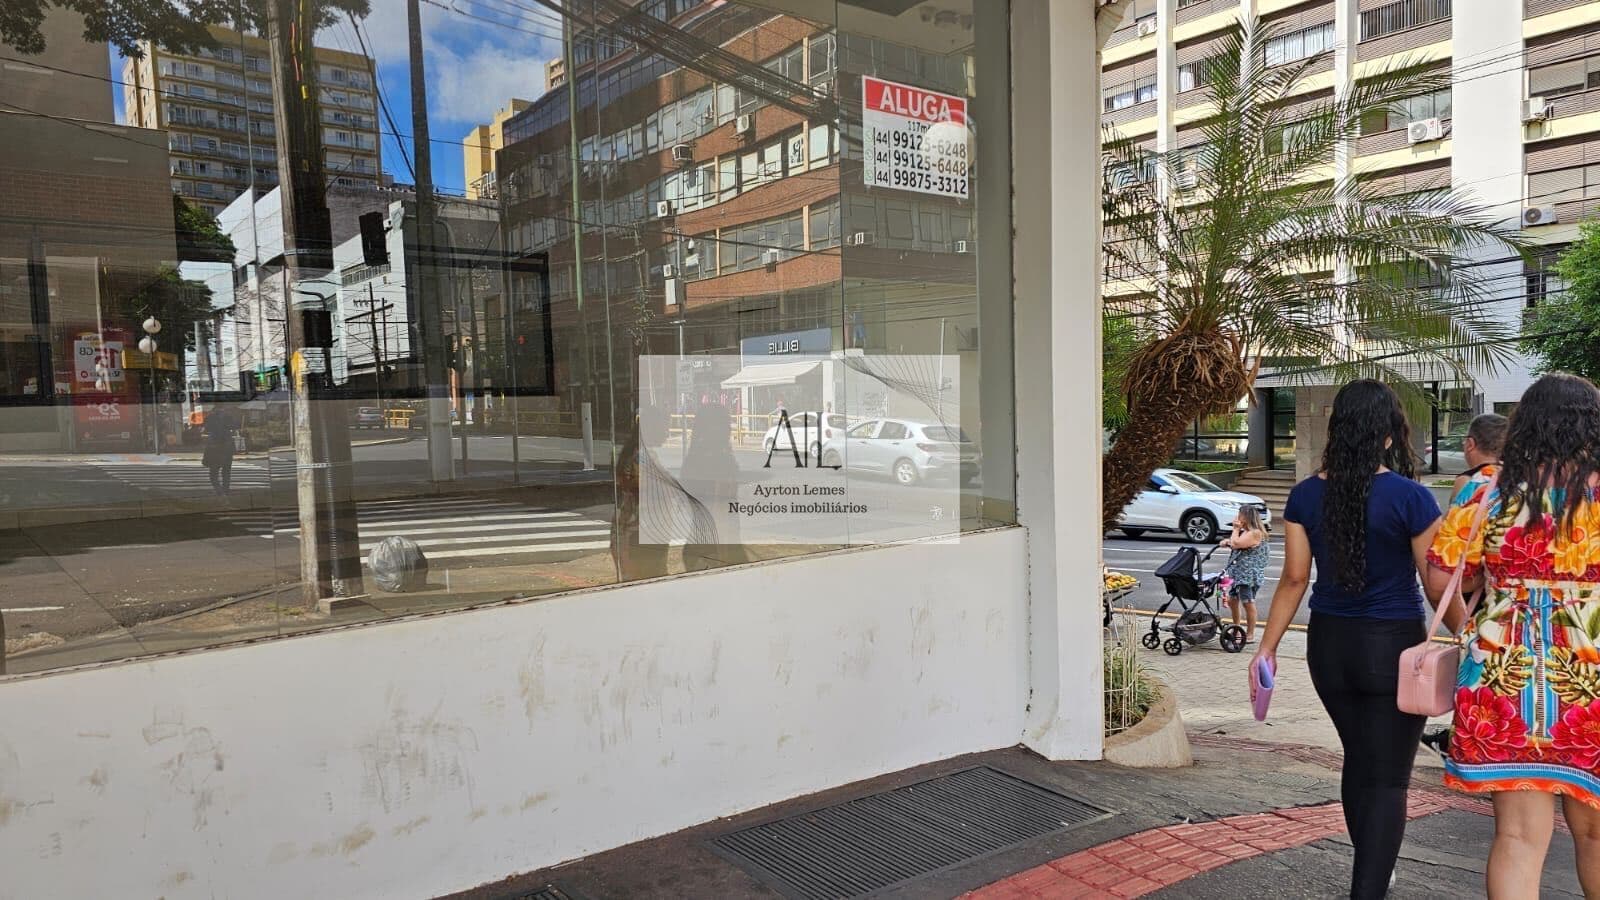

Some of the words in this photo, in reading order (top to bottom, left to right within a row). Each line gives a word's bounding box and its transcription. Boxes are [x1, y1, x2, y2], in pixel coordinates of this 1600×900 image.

[880, 85, 952, 123] ALUGA
[893, 130, 966, 159] 99125-6248
[893, 149, 967, 177] 99125-6448
[894, 169, 967, 195] 99875-3312
